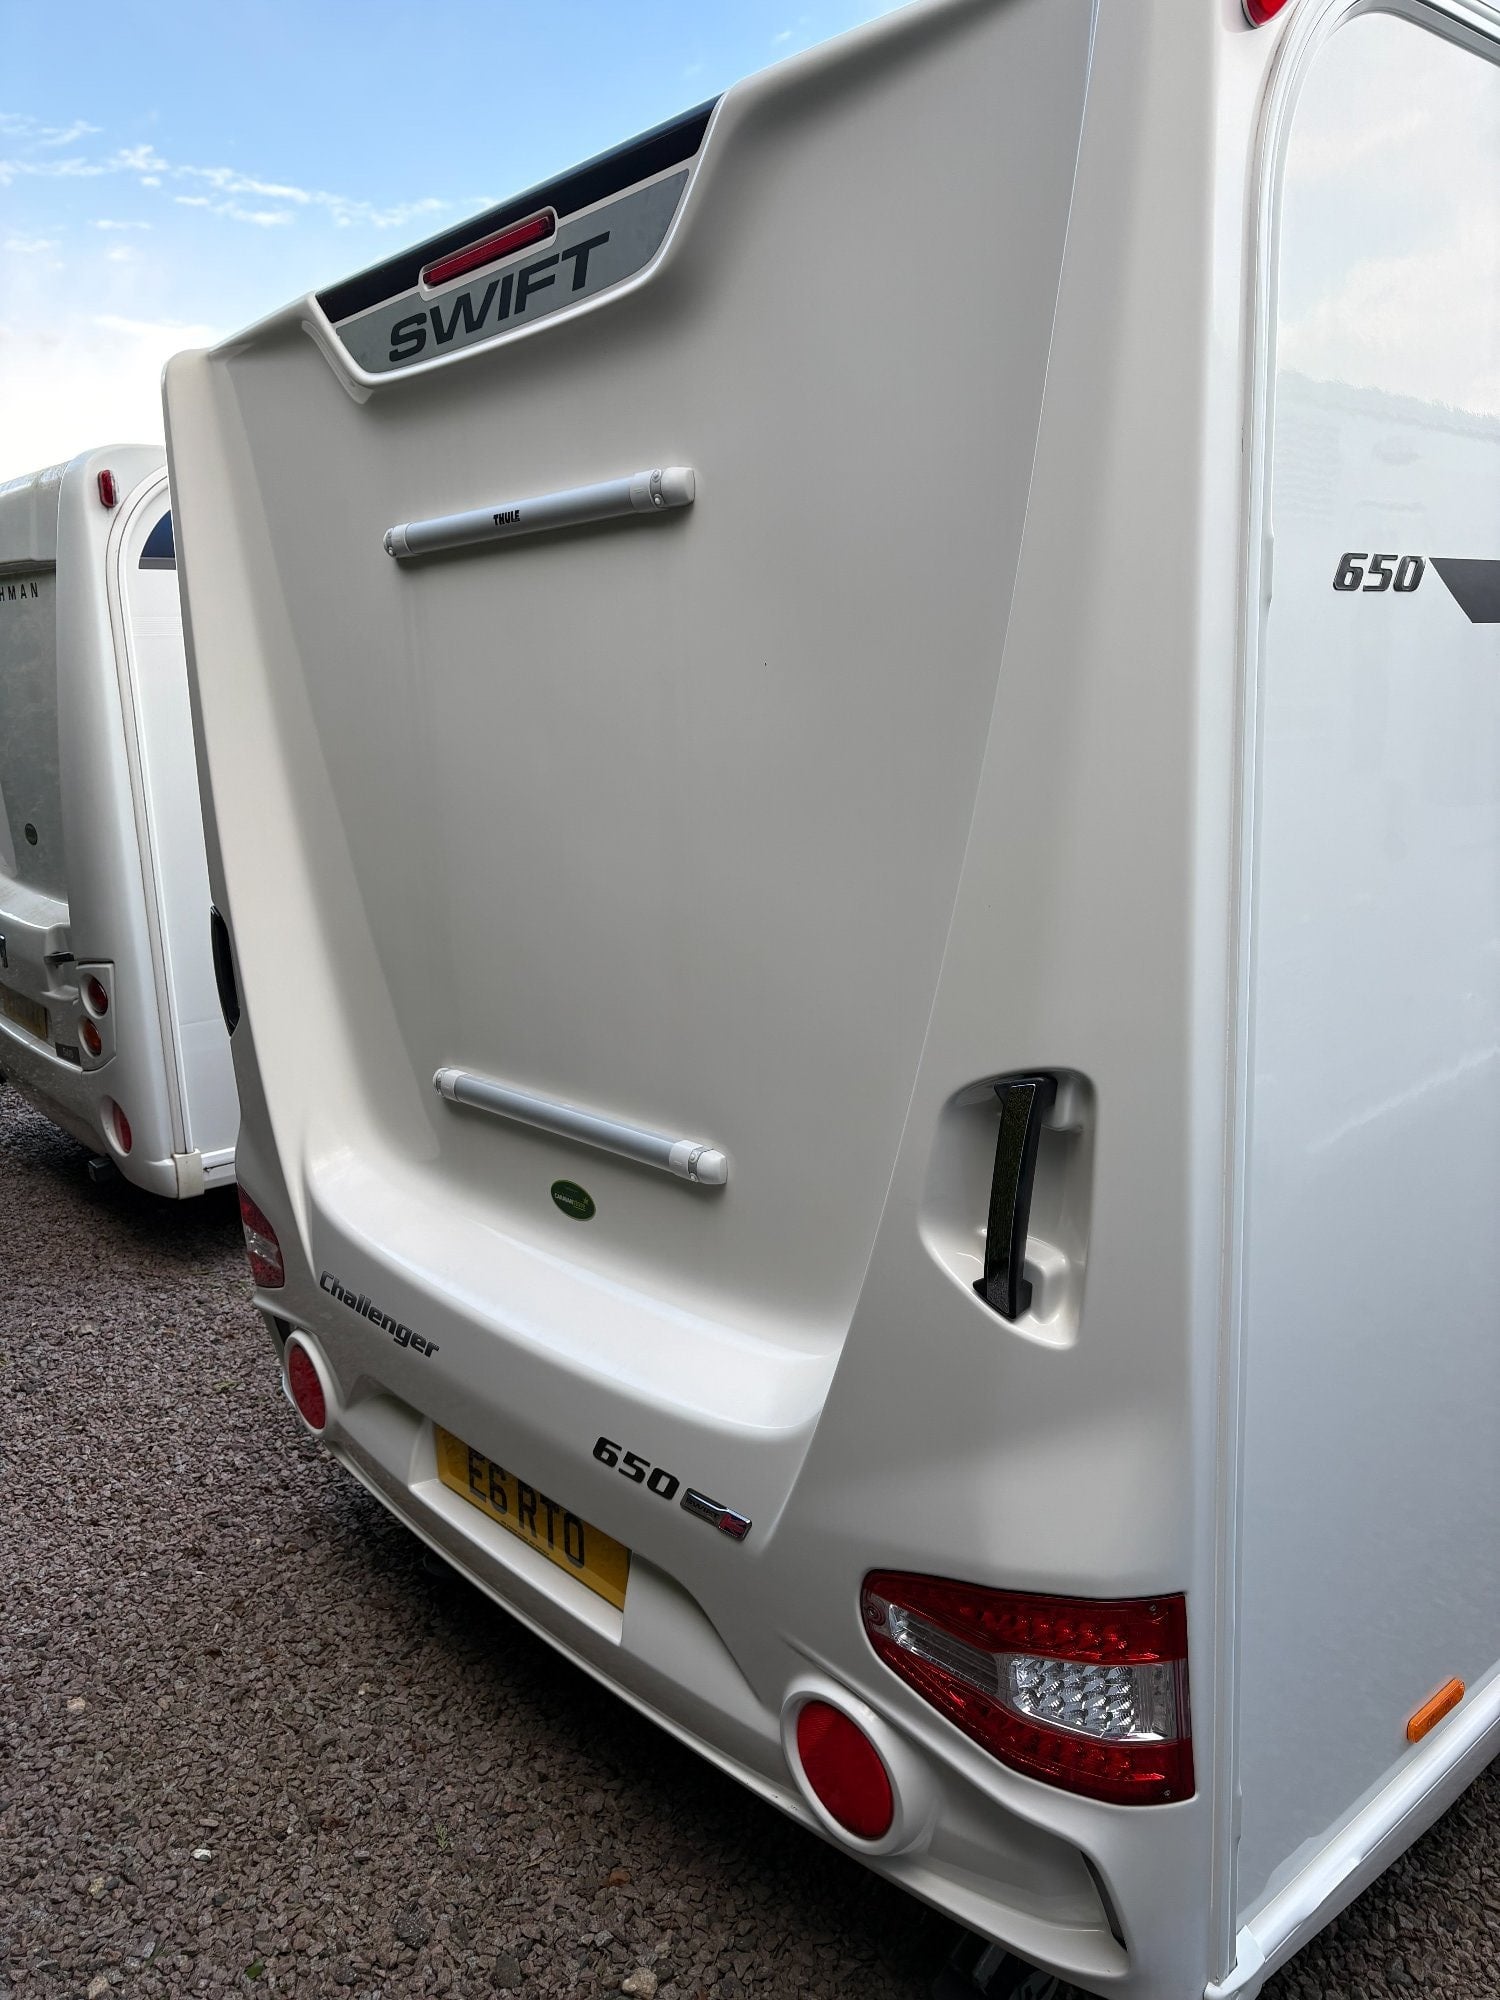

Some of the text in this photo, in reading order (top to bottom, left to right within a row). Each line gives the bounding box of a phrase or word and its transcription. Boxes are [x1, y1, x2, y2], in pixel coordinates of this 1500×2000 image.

[389, 231, 610, 362] SWIFT
[493, 510, 520, 525] THULE
[0, 582, 39, 601] HMAN
[1333, 552, 1426, 592] 650
[320, 1271, 440, 1357] Challenger
[593, 1436, 680, 1500] 650
